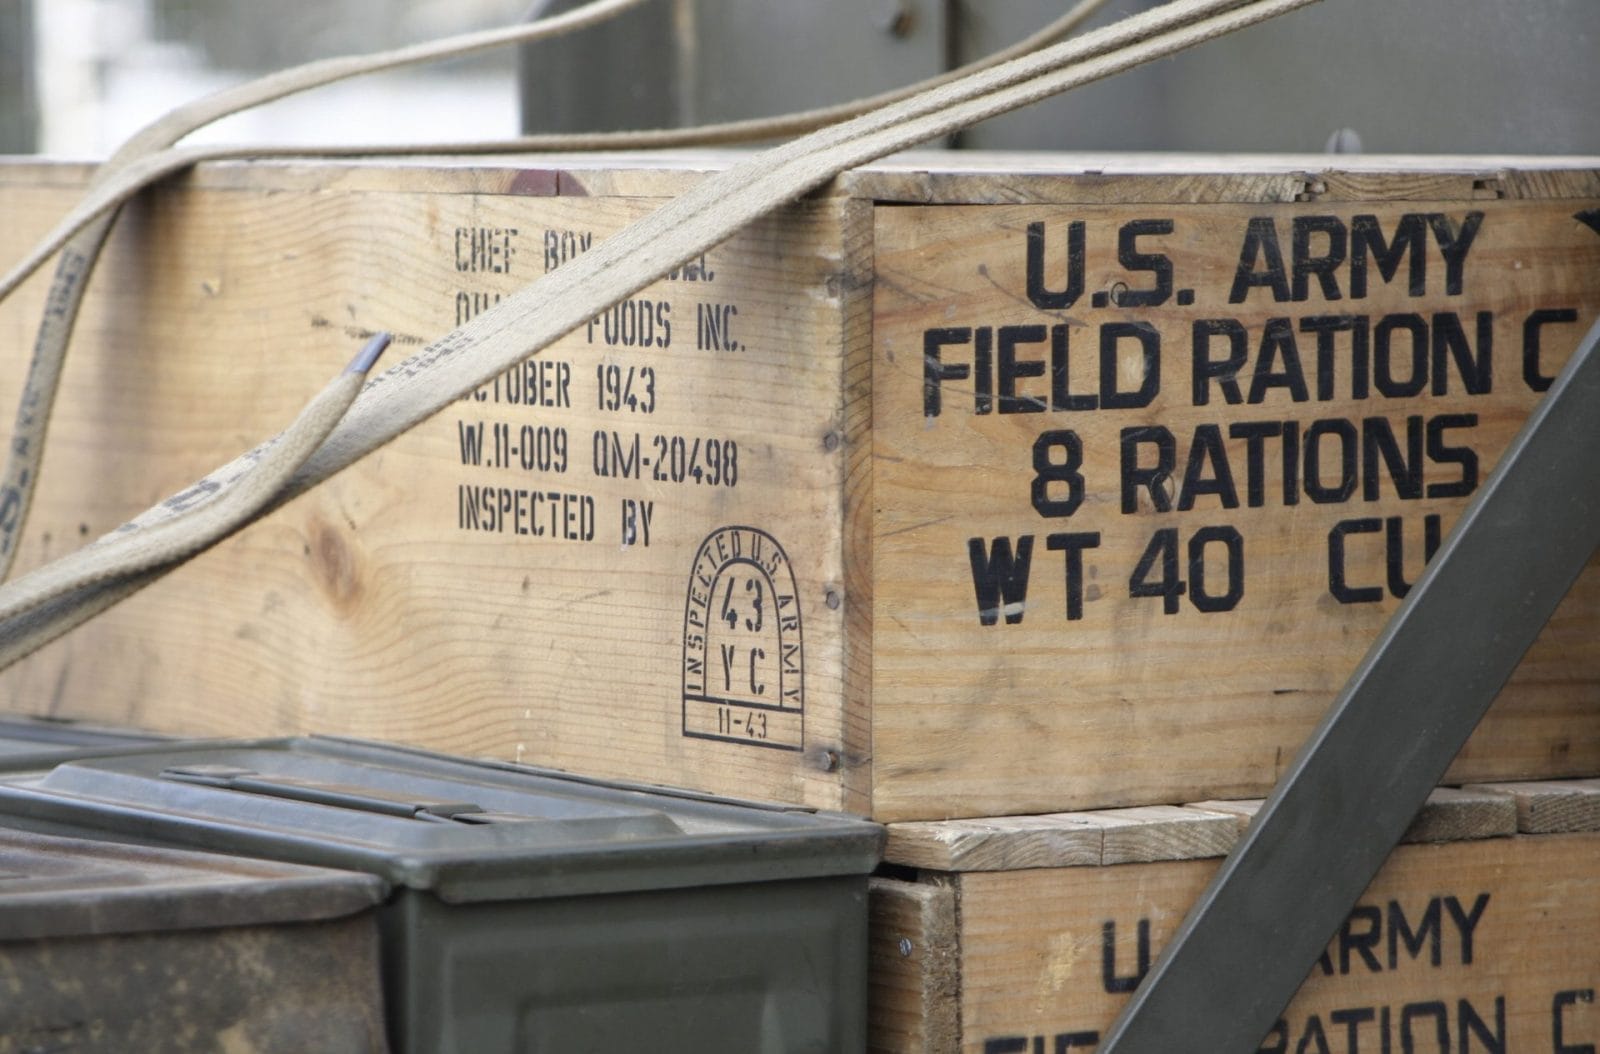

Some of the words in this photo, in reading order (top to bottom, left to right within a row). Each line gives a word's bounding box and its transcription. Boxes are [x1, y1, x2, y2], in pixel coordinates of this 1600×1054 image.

[455, 227, 518, 273] CHEF
[1026, 219, 1195, 309] U.S.
[1229, 211, 1485, 304] ARMY
[697, 303, 746, 351] INC.
[464, 360, 571, 408] OBER
[597, 364, 655, 414] 1943
[923, 321, 1161, 417] FIELD
[1192, 311, 1493, 406] RATION
[593, 430, 738, 487] QM-20498
[1031, 429, 1083, 518] 8
[1120, 414, 1479, 515] RATIONS
[458, 485, 595, 541] INSPECTED
[622, 499, 653, 547] BY
[721, 577, 763, 632] 43
[969, 531, 1101, 626] WT
[1129, 526, 1244, 615] 40
[1328, 514, 1442, 604] CU
[686, 530, 741, 691] INSPECTED
[777, 595, 800, 701] ARMY
[1318, 893, 1490, 976] RMY
